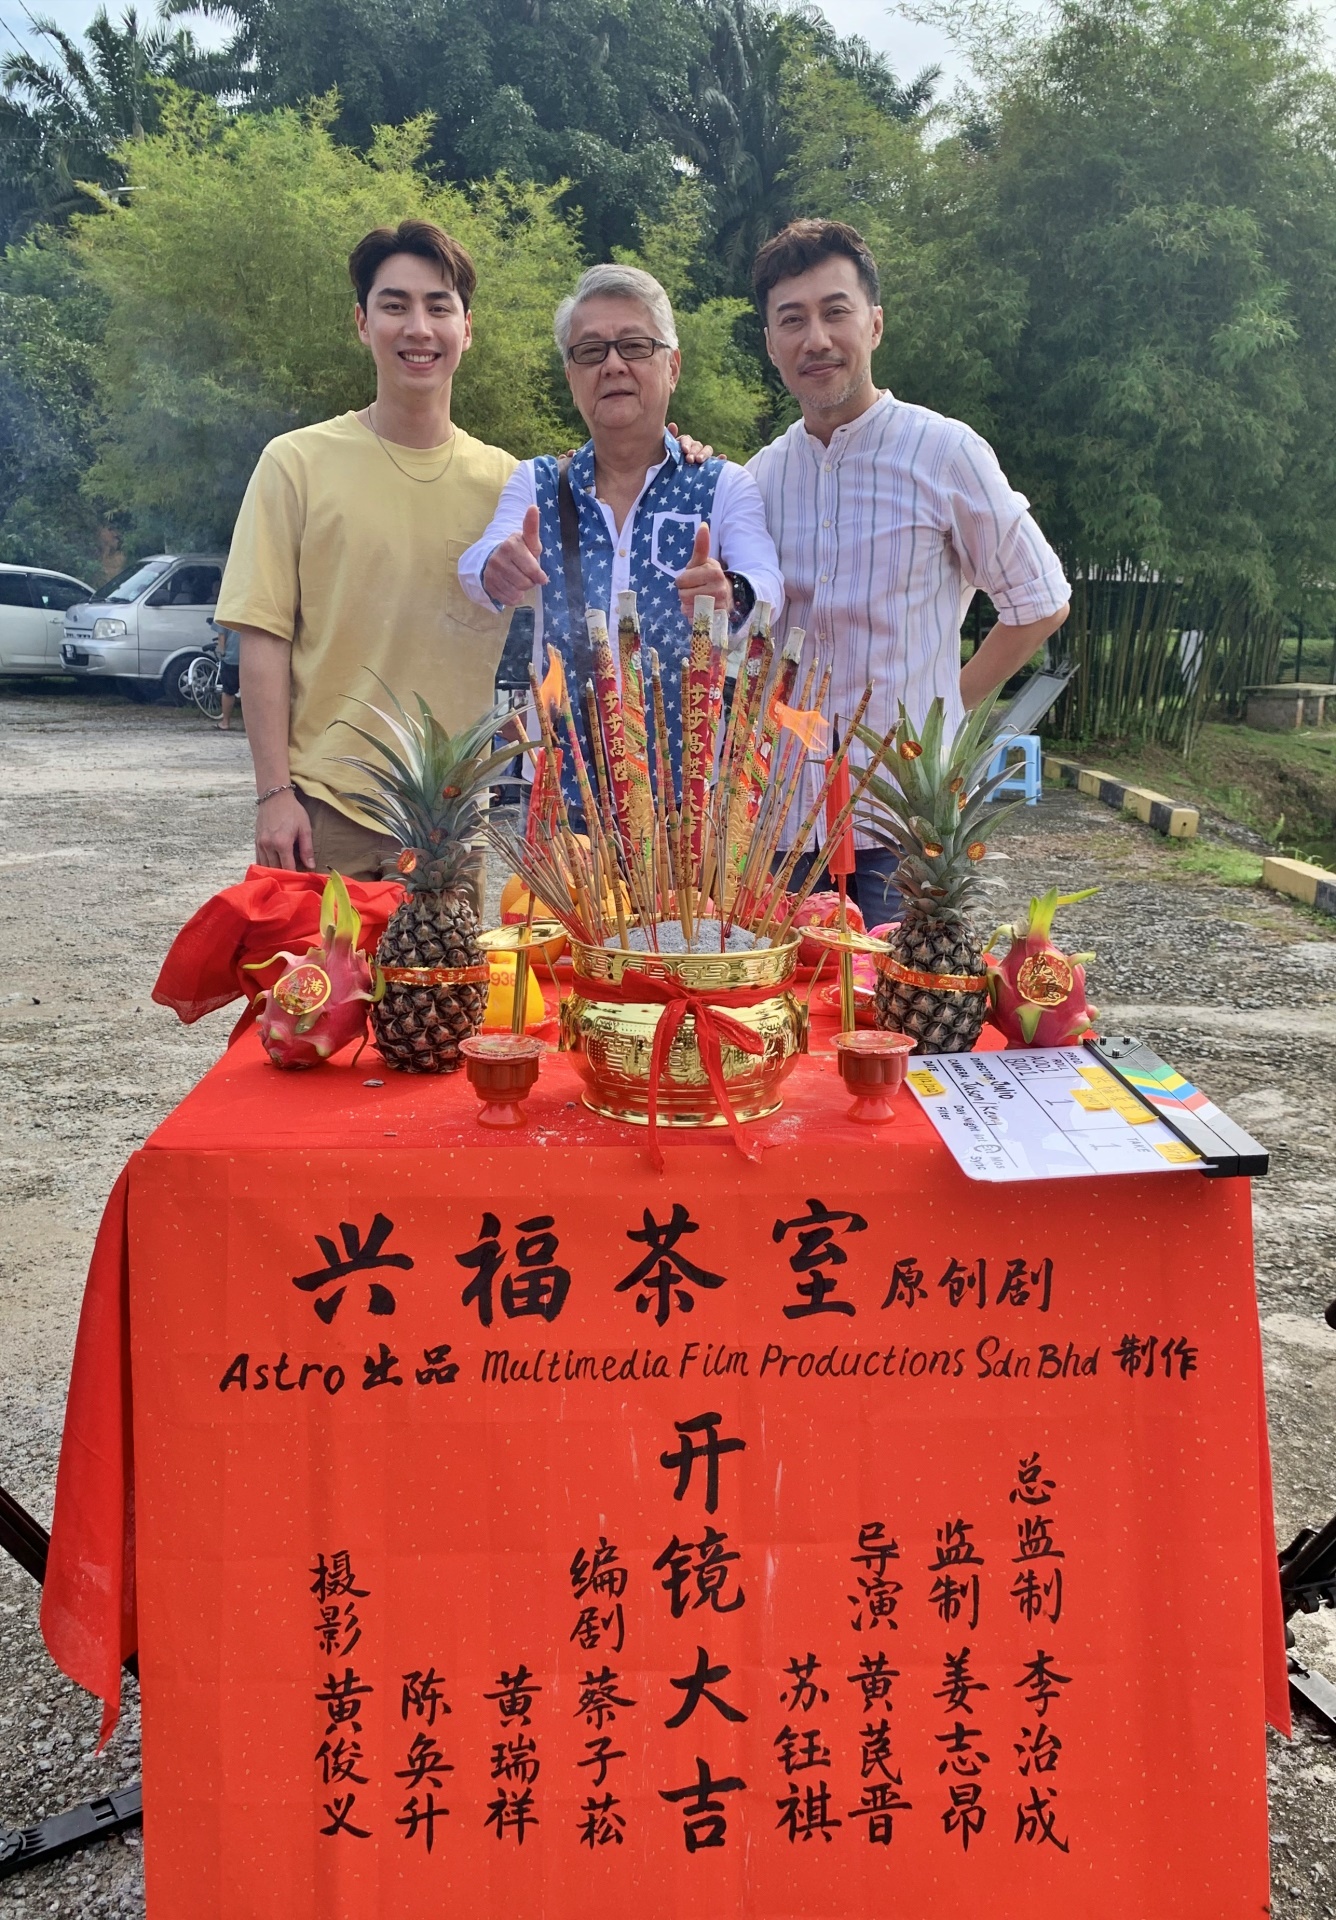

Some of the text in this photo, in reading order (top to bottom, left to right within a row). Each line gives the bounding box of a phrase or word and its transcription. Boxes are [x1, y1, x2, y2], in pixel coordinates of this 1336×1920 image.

[302, 976, 324, 996] 满
[922, 1060, 940, 1072] DATE
[935, 1106, 952, 1120] Filter
[990, 1080, 1018, 1100] Julio
[1024, 1055, 1060, 1074] A001
[1051, 1058, 1070, 1071] ROLL
[969, 1155, 987, 1171] Sync
[1126, 1137, 1151, 1153] TAKE
[292, 1199, 1054, 1328] 兴福茶室 原创剧
[219, 1333, 1199, 1396] Astro 出品 Multimedia Film Productions Sdn Bhd 制作
[847, 1521, 903, 1632] 导演
[652, 1411, 749, 1854] 开镜大吉
[927, 1518, 990, 1852] 监制 姜志昂
[1009, 1452, 1072, 1854] 总监制 李治成
[308, 1549, 374, 1839] 摄影 黄俊义
[569, 1536, 637, 1850] 编剧 蔡子菘
[773, 1652, 843, 1844] 苏钰祺
[394, 1667, 454, 1854] 陈奂升
[483, 1664, 542, 1846] 黄瑞祥
